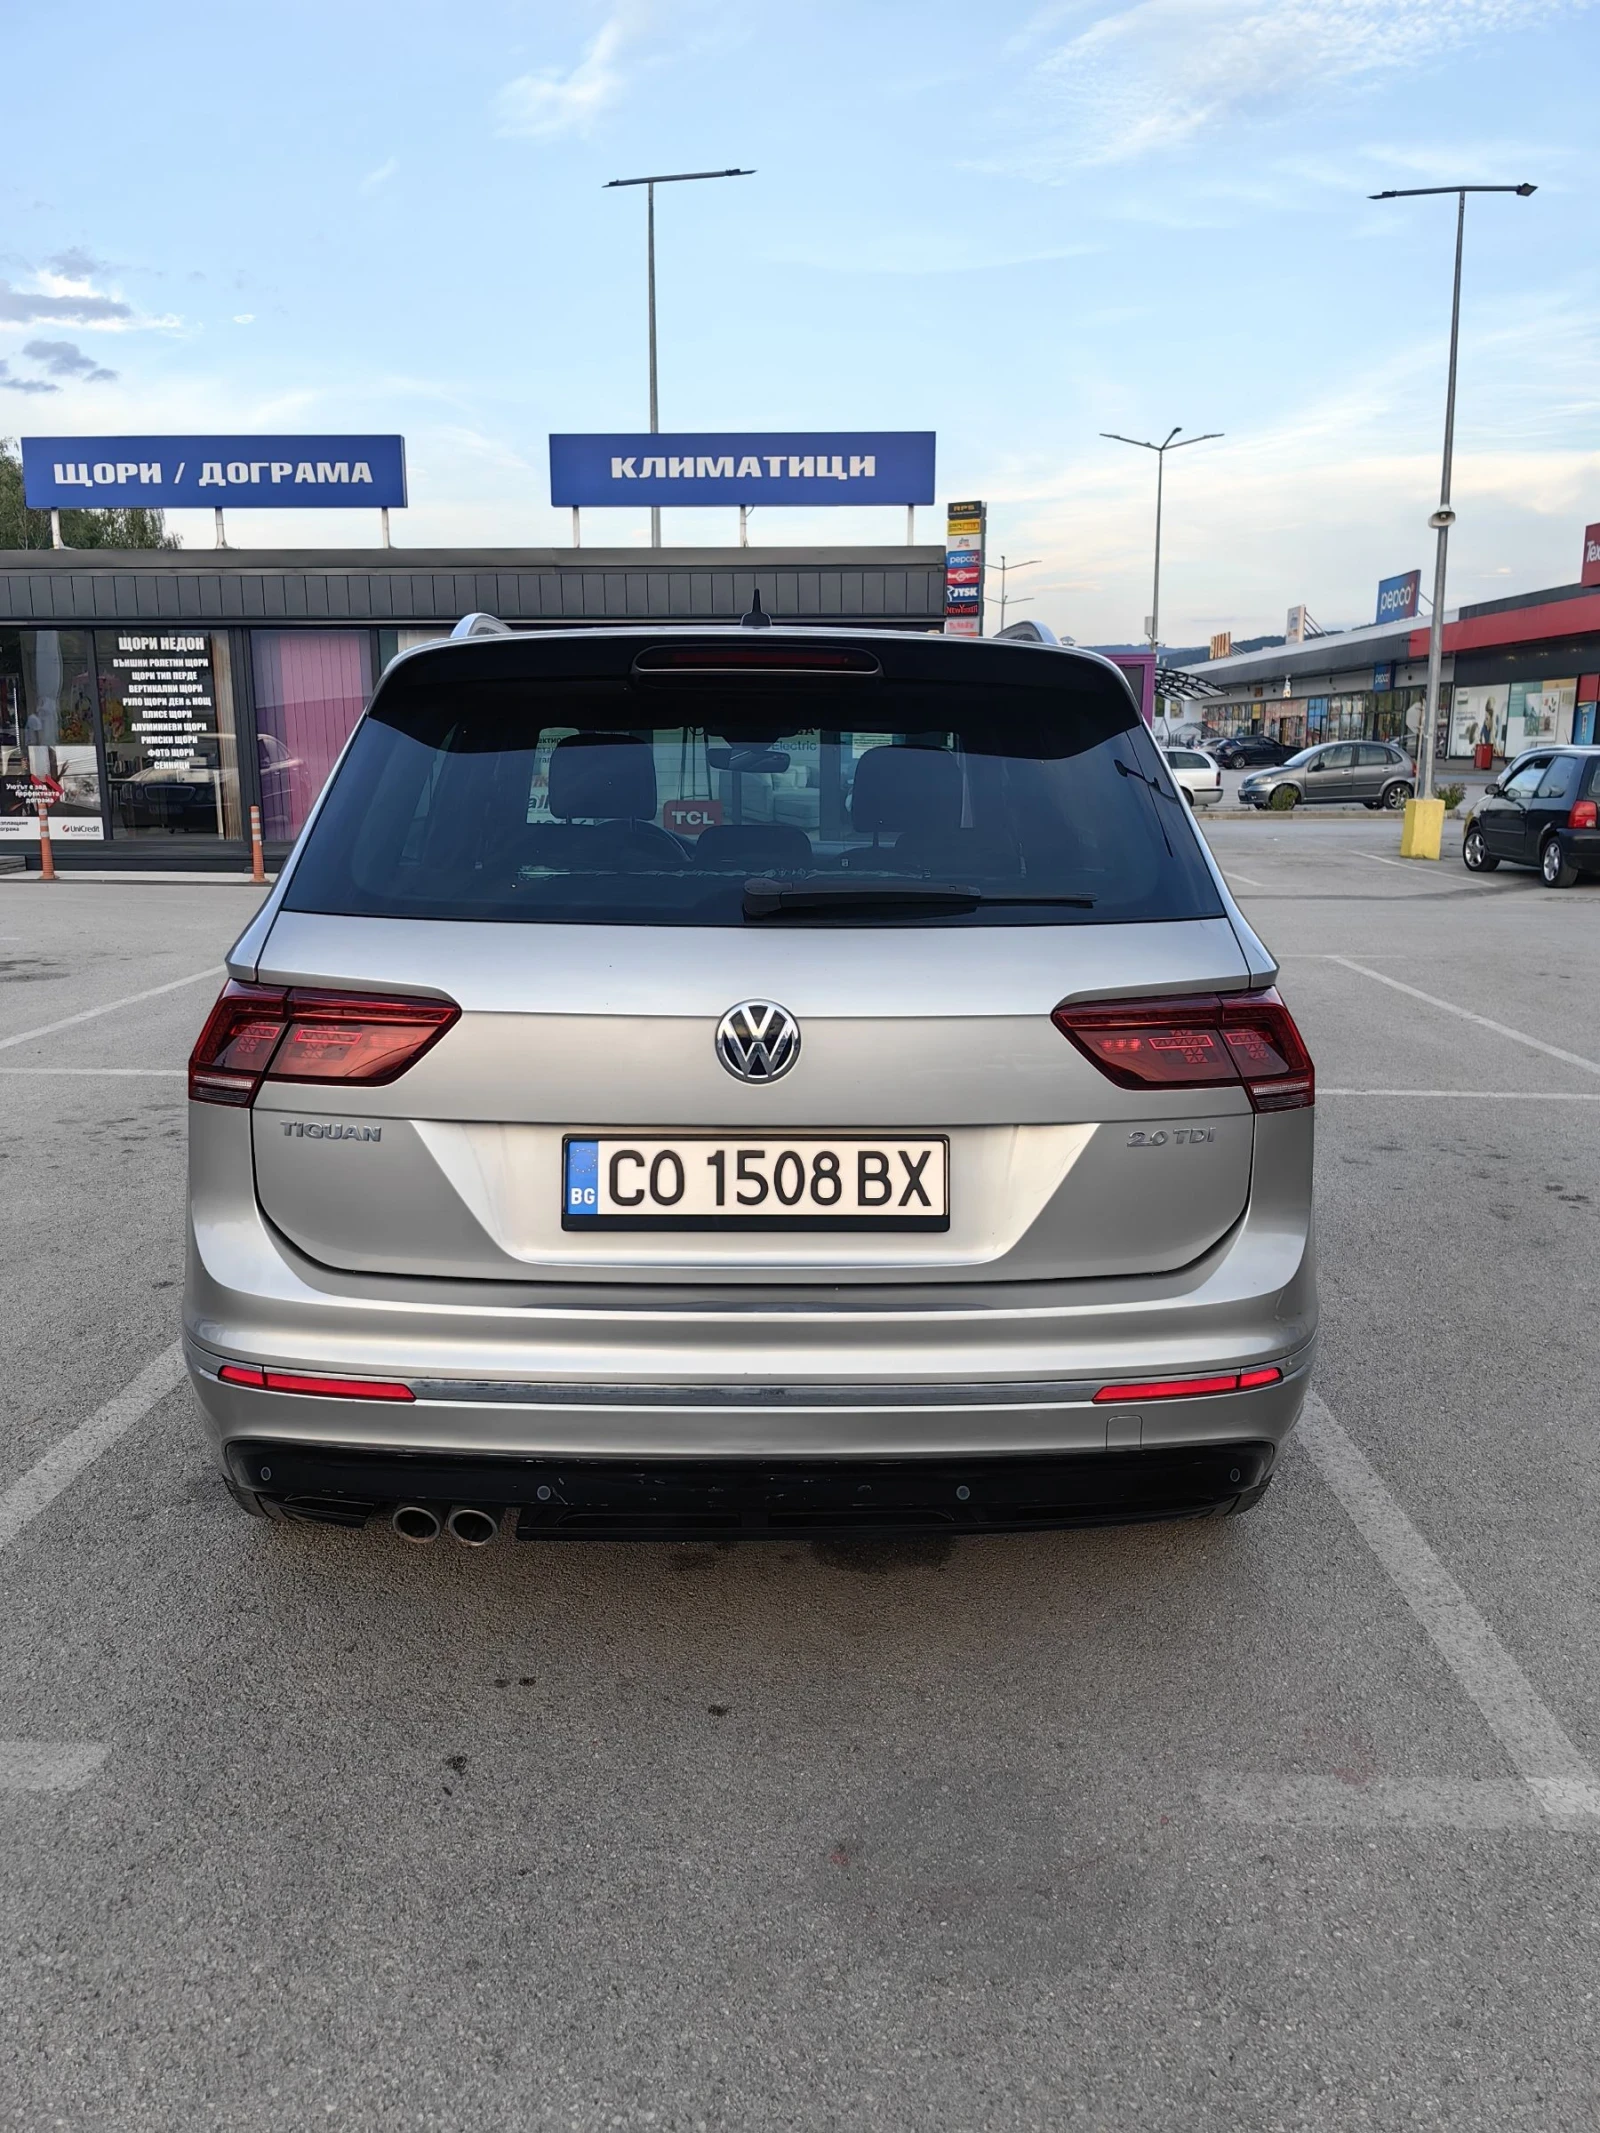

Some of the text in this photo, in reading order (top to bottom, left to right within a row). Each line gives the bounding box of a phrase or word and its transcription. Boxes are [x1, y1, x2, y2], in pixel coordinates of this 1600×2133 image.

[611, 456, 876, 480] КЛИМАТИЦИ
[53, 462, 373, 487] ЩОРИ / ДОГРАМА
[950, 556, 976, 565] pepco
[952, 587, 978, 597] JYSK
[1380, 586, 1412, 614] pepco
[118, 636, 205, 652] ЩОРИ НЕДОН
[149, 659, 184, 668] РОЛЕТНИ
[185, 659, 208, 668] ЩОРИ
[132, 671, 198, 681] ЩОРИ ТИП ПЕРДЕ
[1375, 673, 1390, 684] pepco
[129, 684, 203, 694] ВЕРТИКАЛНИ ЩОРИ
[123, 698, 143, 706] РУЛО
[144, 697, 167, 707] ЩОРИ
[168, 697, 184, 706] ДЕН
[192, 697, 212, 706] НОЩ
[142, 710, 192, 719] ПЛИСЕ ЩОРИ
[131, 723, 207, 732] АЛУМИНИЕВИ ЩОРИ
[141, 736, 198, 745] РИМСКИ ЩОРИ
[772, 741, 817, 751] Electric
[147, 749, 194, 758] ФОТО ЩОРИ
[672, 811, 714, 825] TCL
[70, 825, 100, 833] UniCredit
[280, 1121, 382, 1142] TIGUAN
[1173, 1127, 1216, 1144] TDI
[609, 1149, 932, 1207] CO 1508 BX
[571, 1188, 595, 1205] BG
